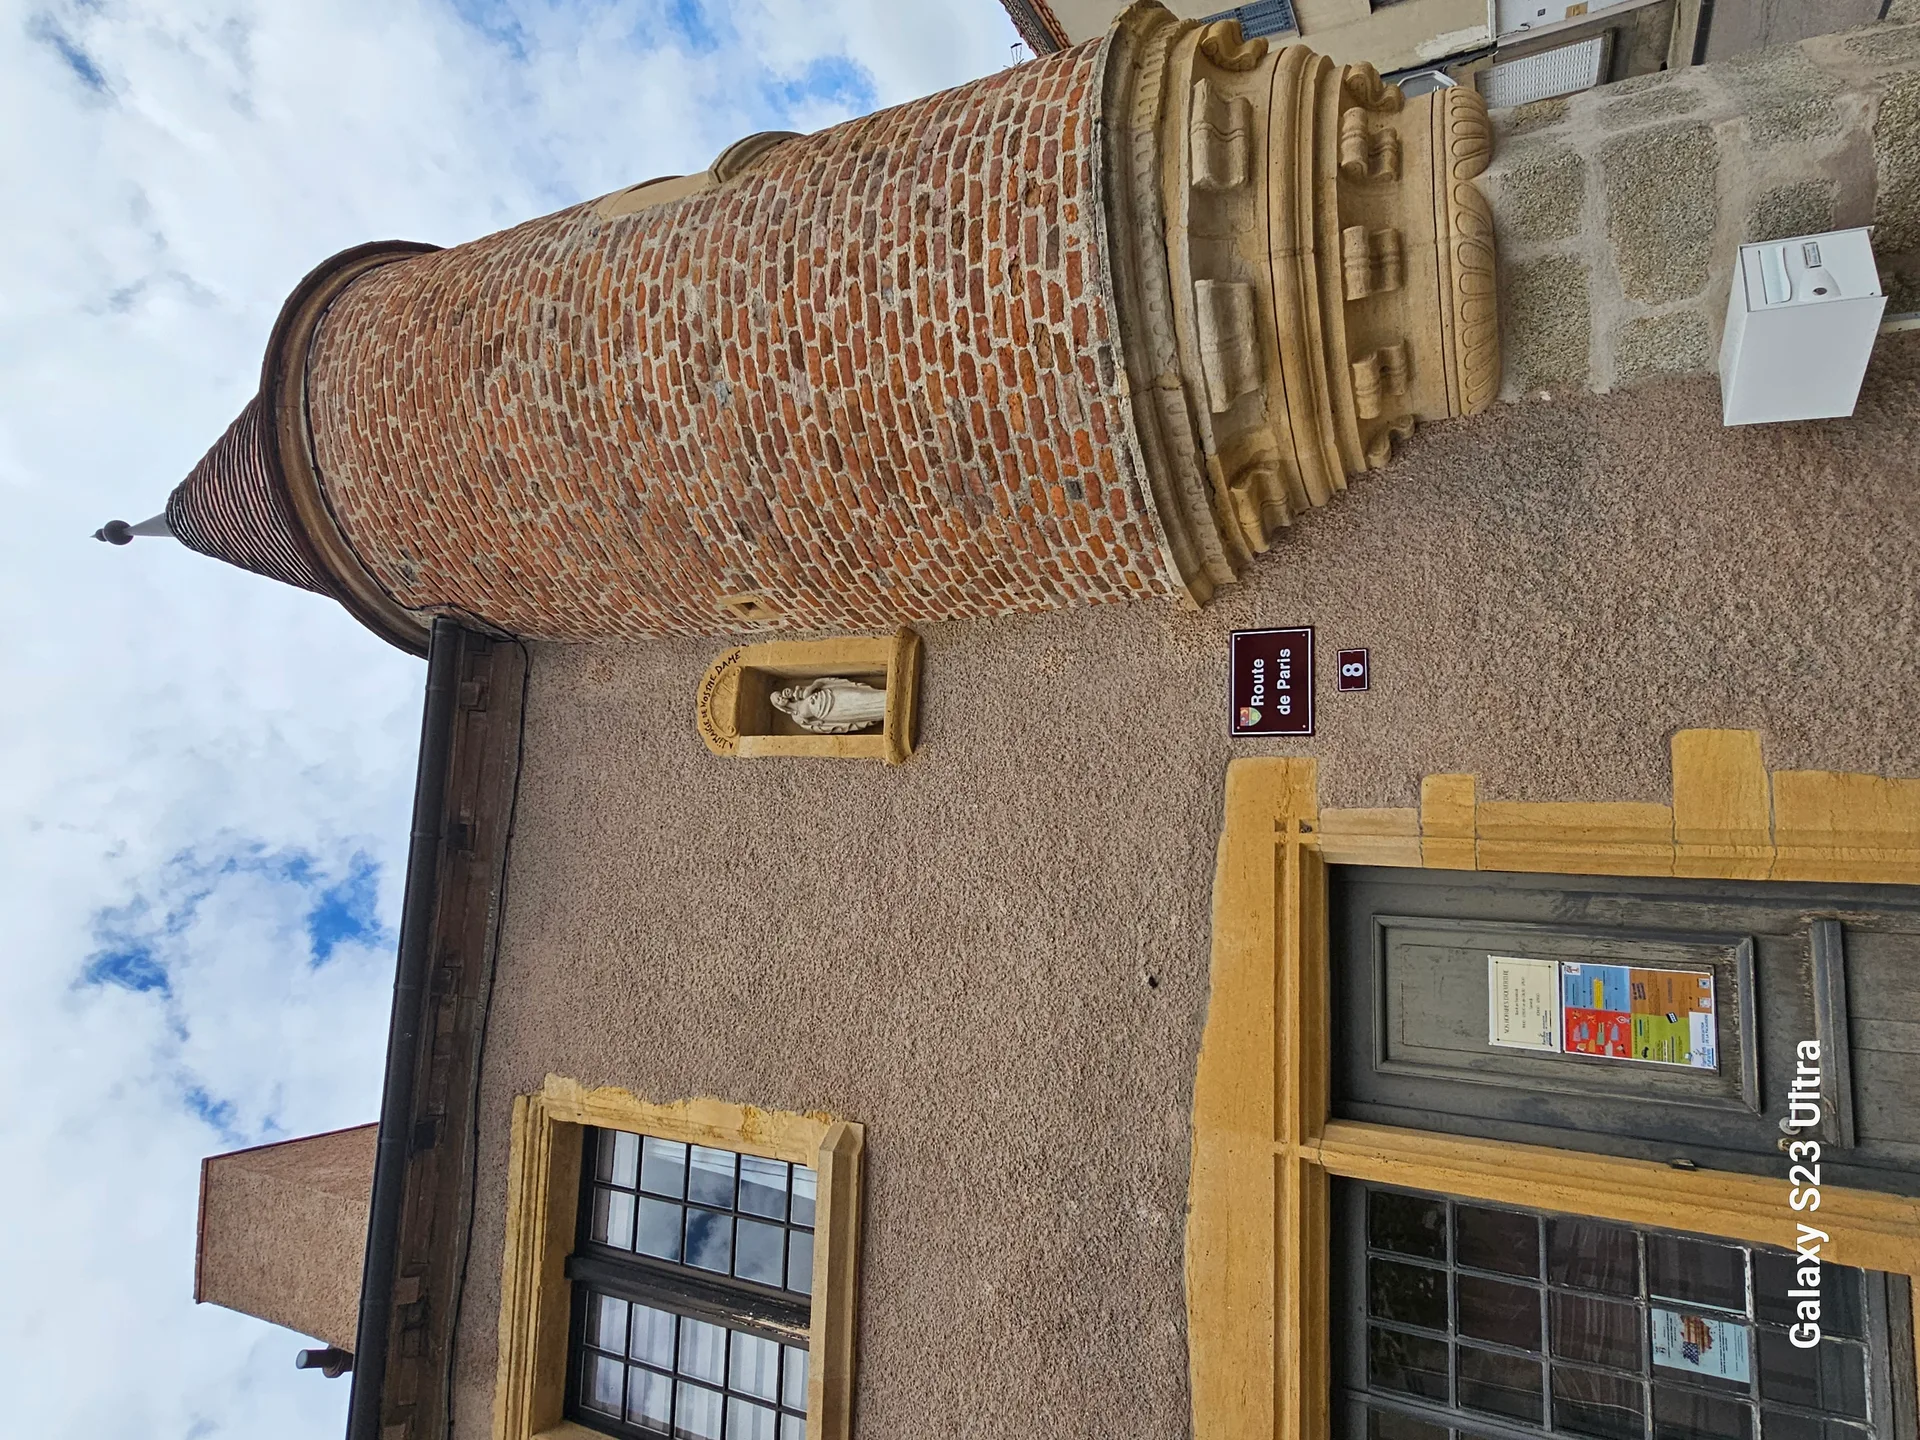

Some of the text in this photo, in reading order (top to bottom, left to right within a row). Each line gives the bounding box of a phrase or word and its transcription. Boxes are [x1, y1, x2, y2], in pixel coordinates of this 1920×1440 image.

[714, 650, 742, 675] DAME
[1341, 662, 1364, 678] 8
[700, 674, 717, 708] NOSTRE
[1250, 658, 1265, 707] Route
[1276, 648, 1291, 715] de Paris
[701, 708, 708, 719] DE
